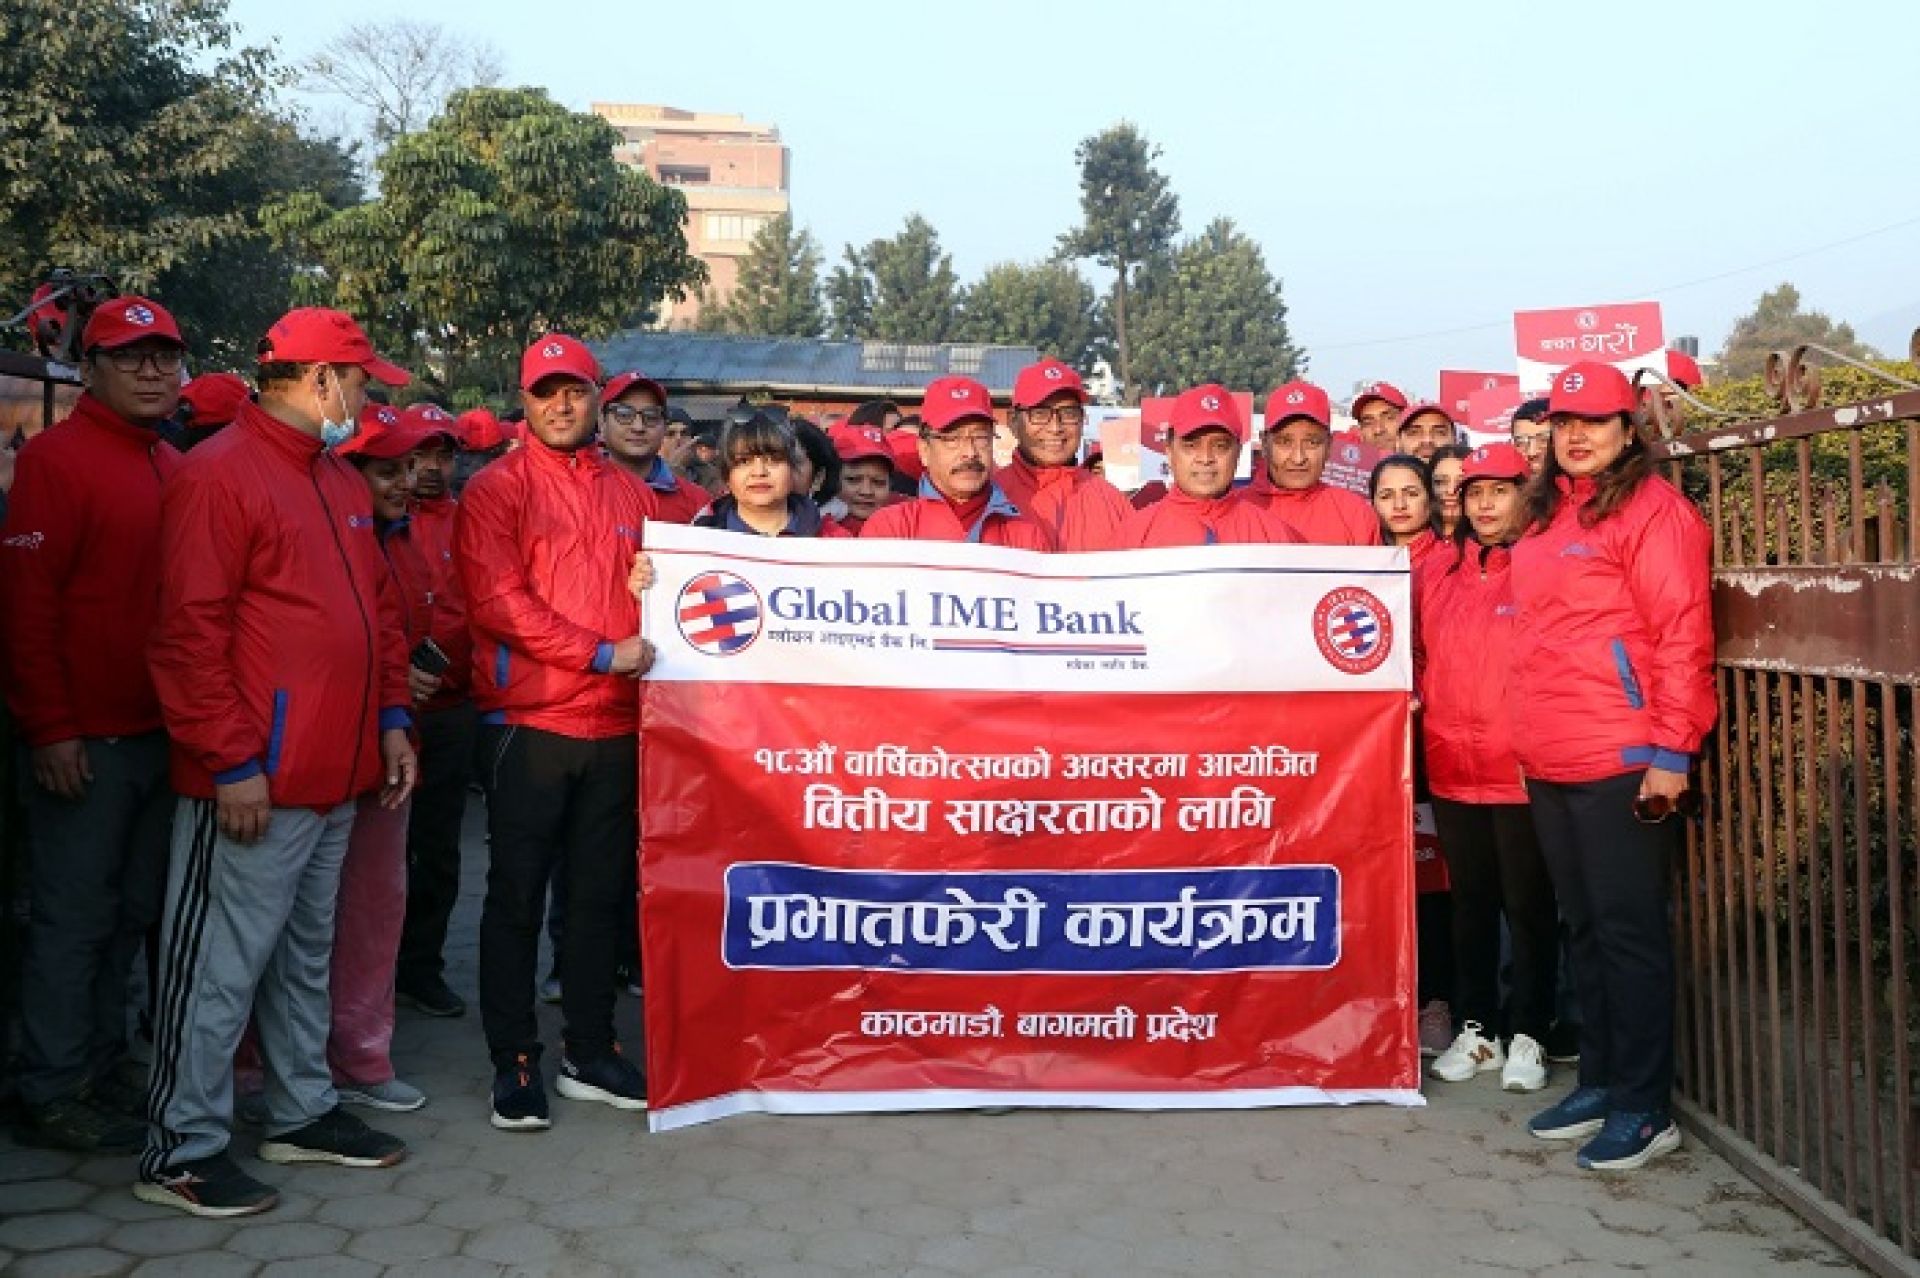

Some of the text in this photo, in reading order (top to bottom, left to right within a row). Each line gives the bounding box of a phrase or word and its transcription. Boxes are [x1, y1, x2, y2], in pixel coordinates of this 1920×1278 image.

[768, 586, 1143, 634] Global IME Bank
[844, 743, 1052, 781] वार्षिकोत्सवको
[1062, 753, 1188, 779] अवसरमा
[1199, 745, 1319, 777] आयोजित
[803, 783, 1276, 836] वित्तीय साक्षरताको लागि
[747, 886, 1321, 951] प्रभातफेरी कार्यक्रम
[1016, 1005, 1139, 1039] बागमती
[1146, 1005, 1218, 1042] प्रदेश
